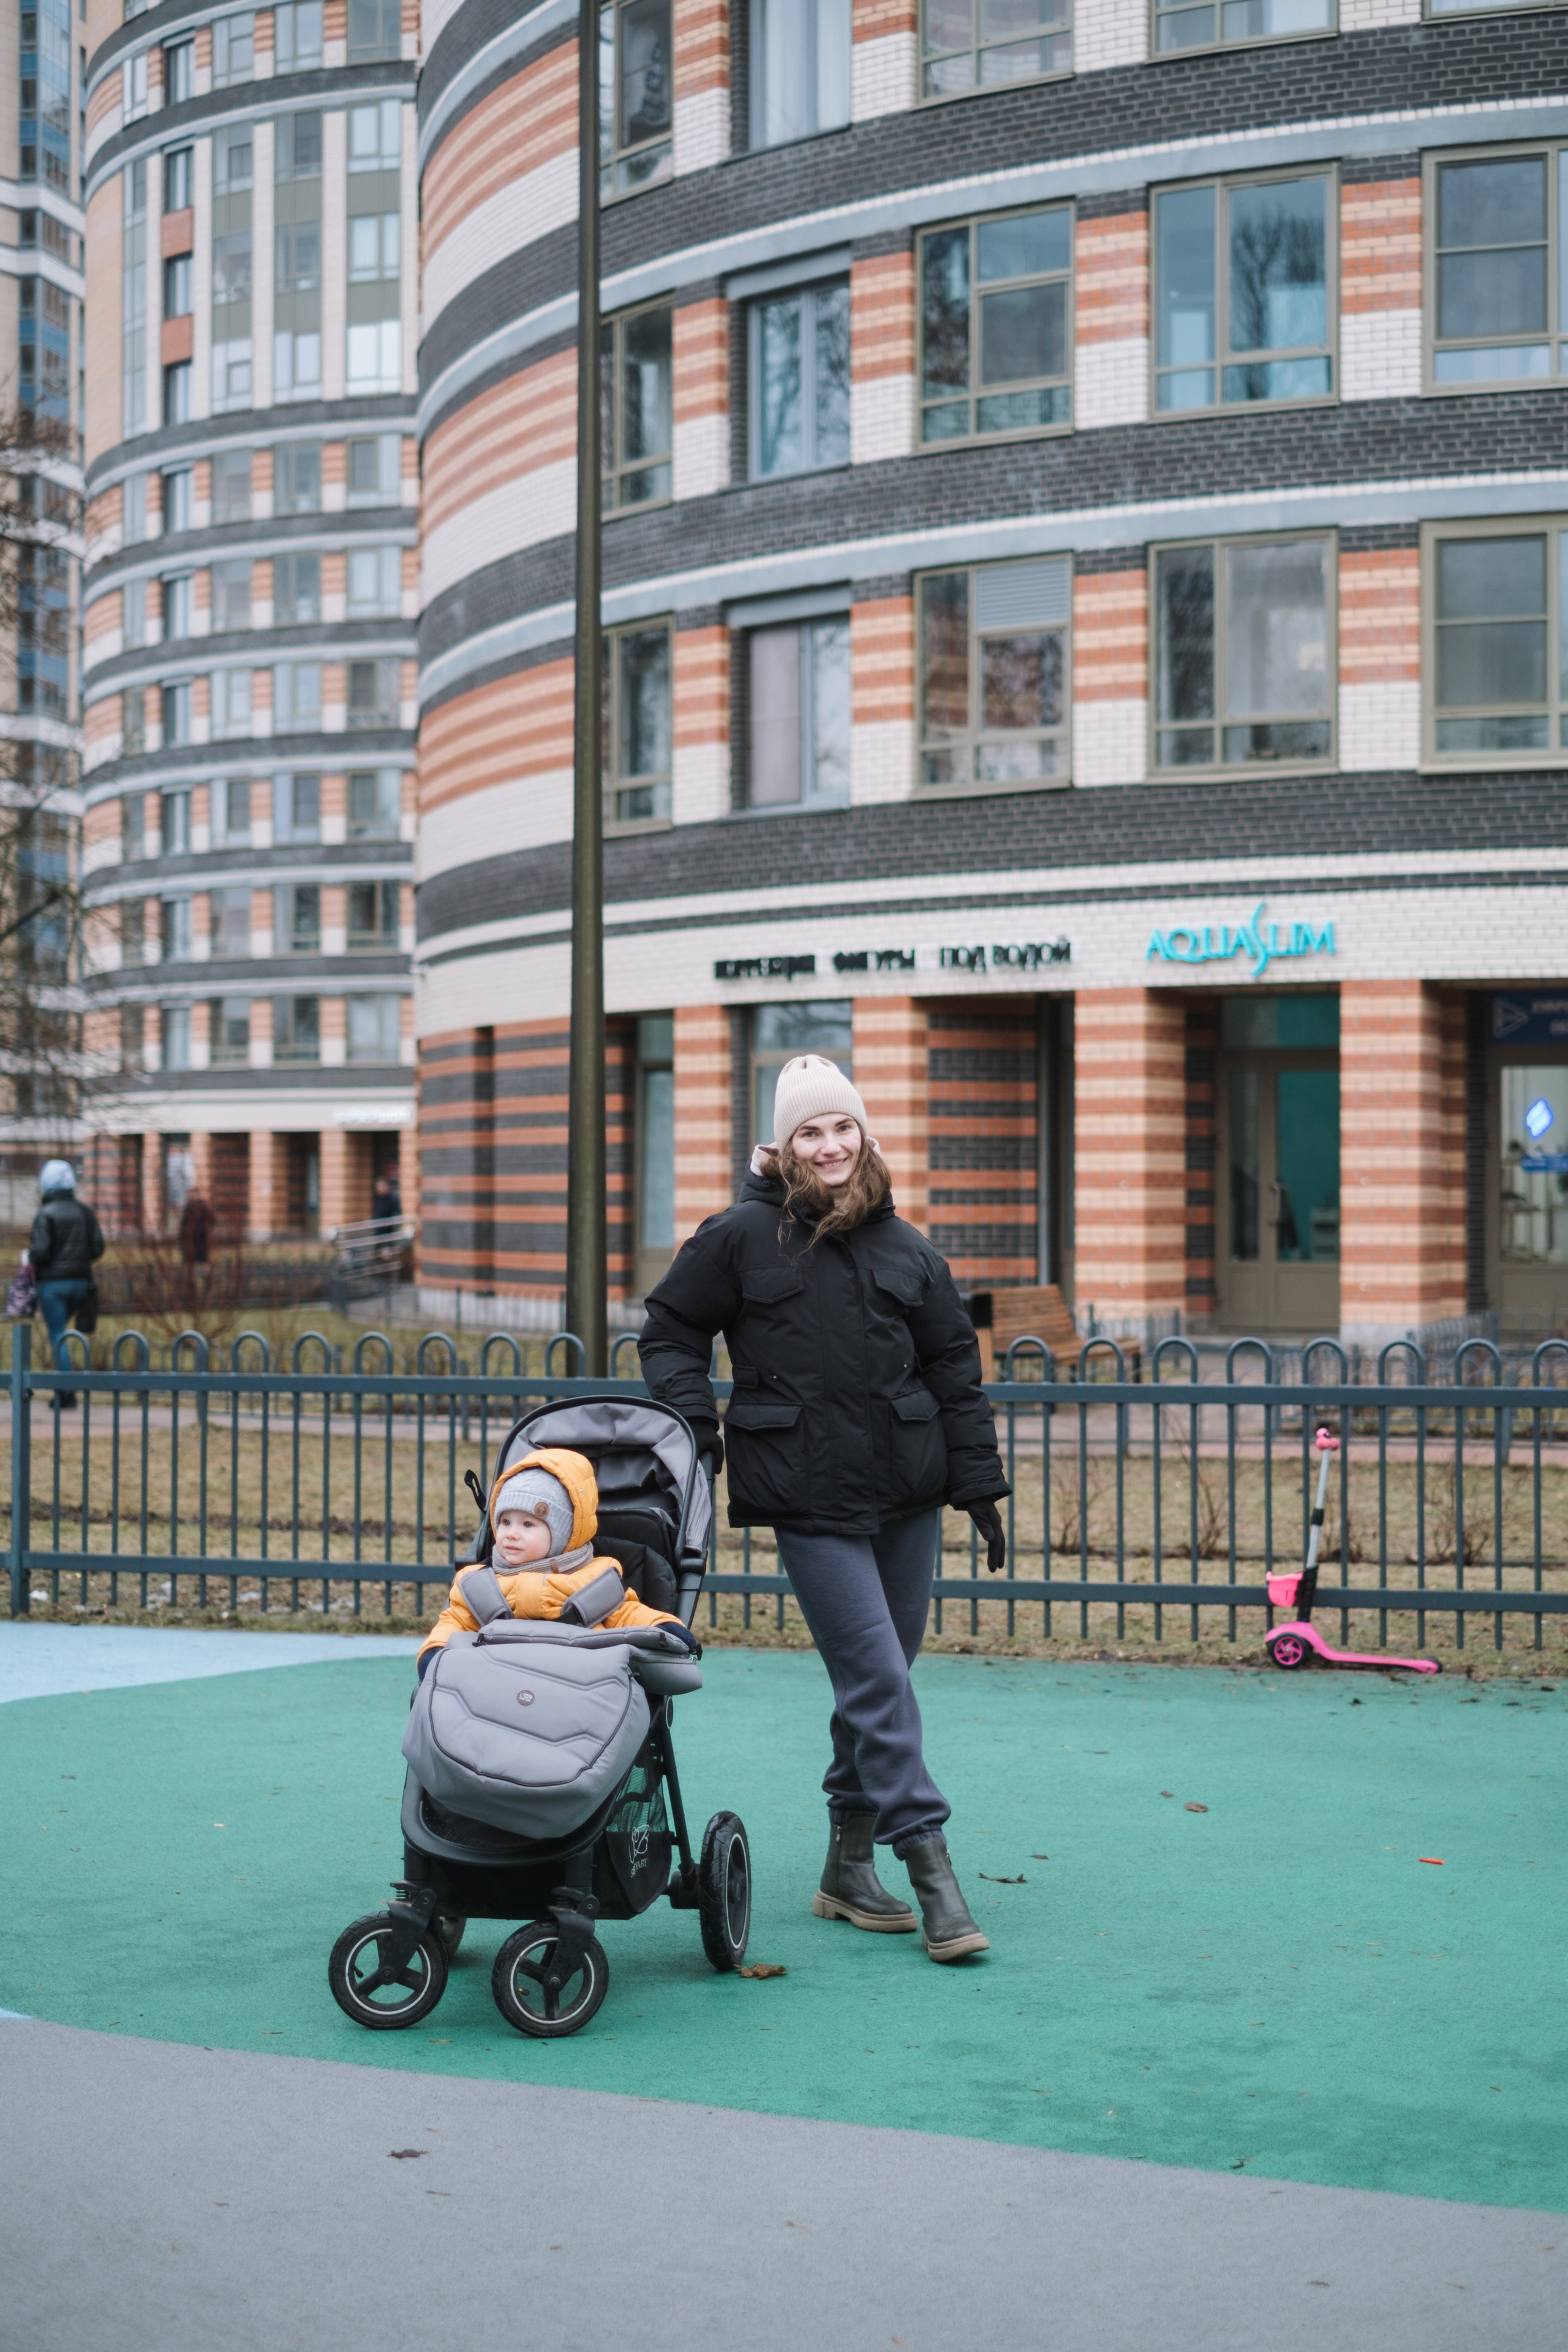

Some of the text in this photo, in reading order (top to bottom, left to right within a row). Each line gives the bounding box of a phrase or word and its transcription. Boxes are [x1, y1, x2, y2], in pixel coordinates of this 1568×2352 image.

[940, 945, 986, 973] ПОД
[992, 937, 1071, 971] ВОДОЙ
[1145, 902, 1336, 977] AQUASLIM
